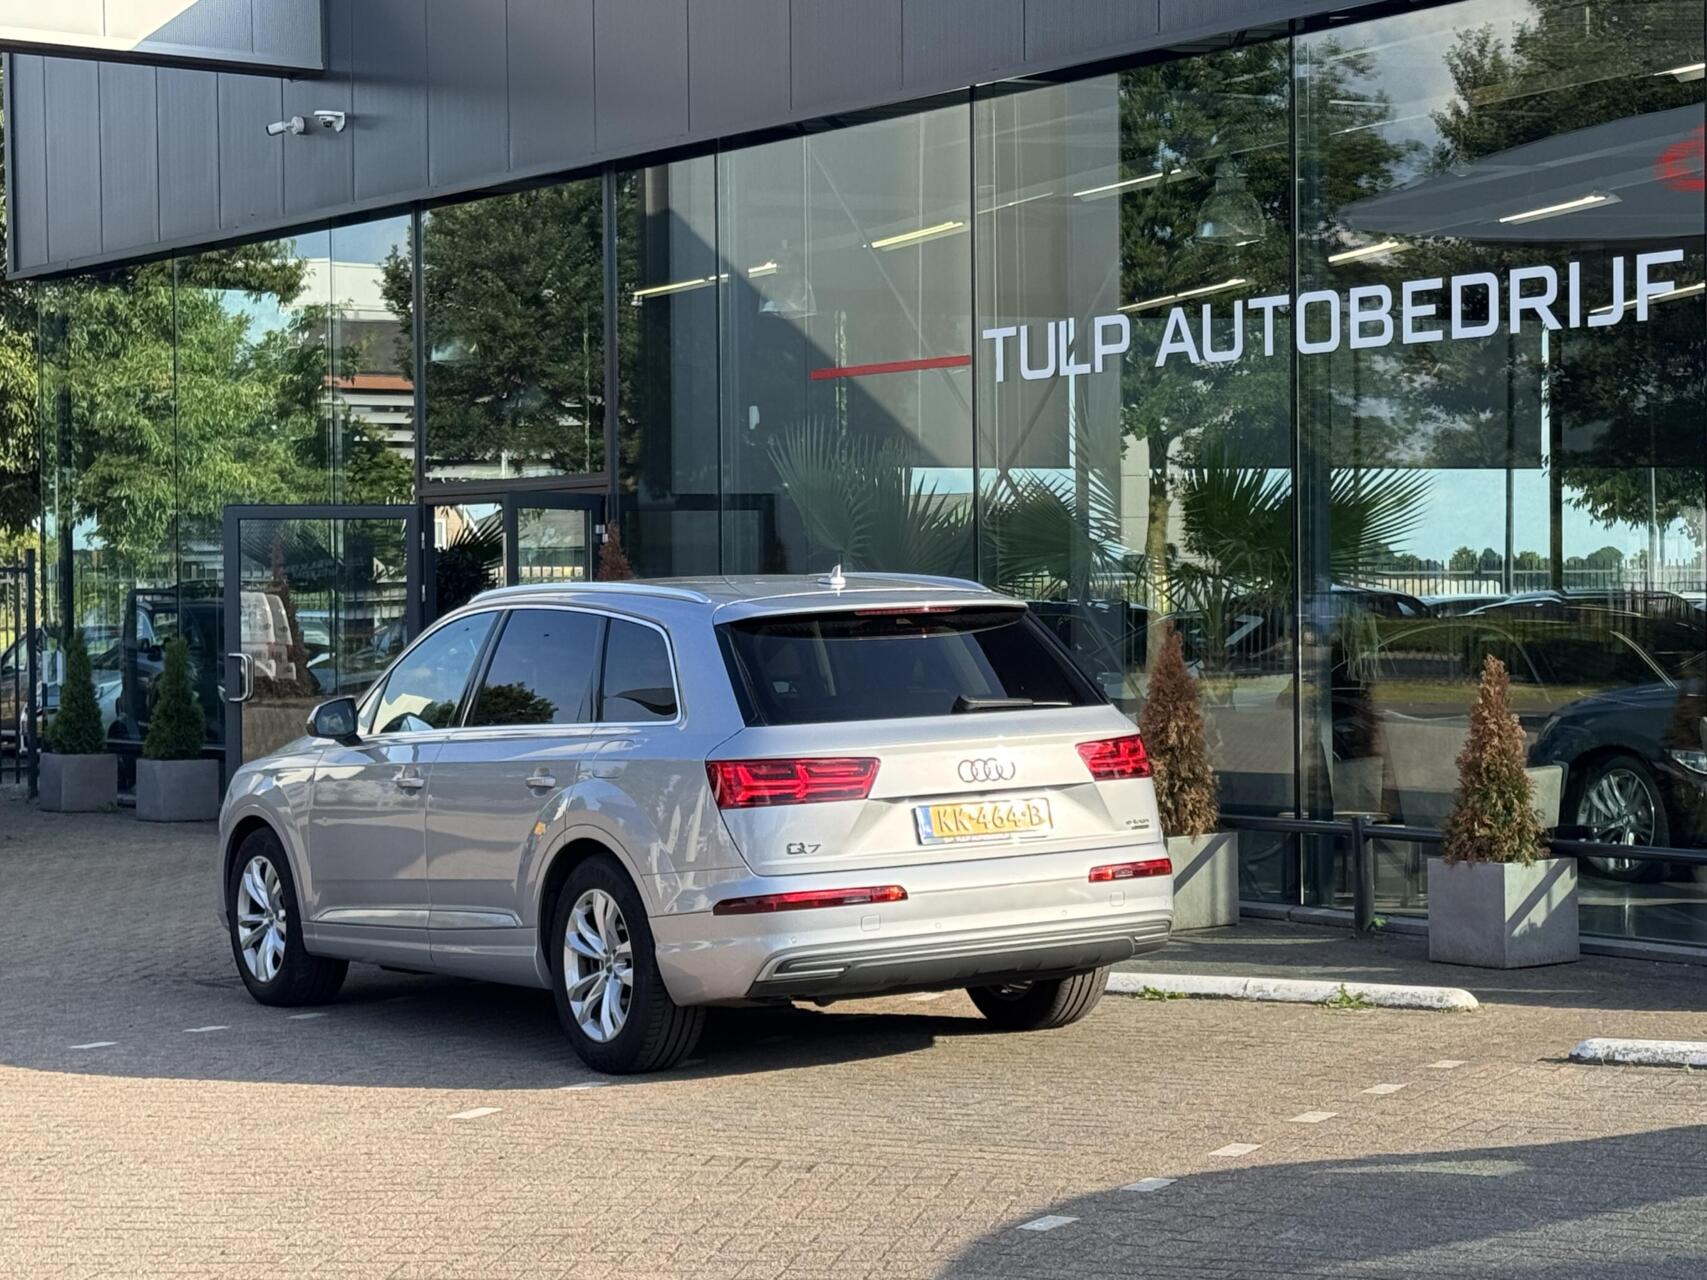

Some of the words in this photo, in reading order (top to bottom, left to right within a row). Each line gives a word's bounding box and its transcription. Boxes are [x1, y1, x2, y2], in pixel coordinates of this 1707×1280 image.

[983, 315, 1130, 382] TULP
[1155, 249, 1684, 367] AUTOBEDRIJF
[786, 842, 821, 855] Q7
